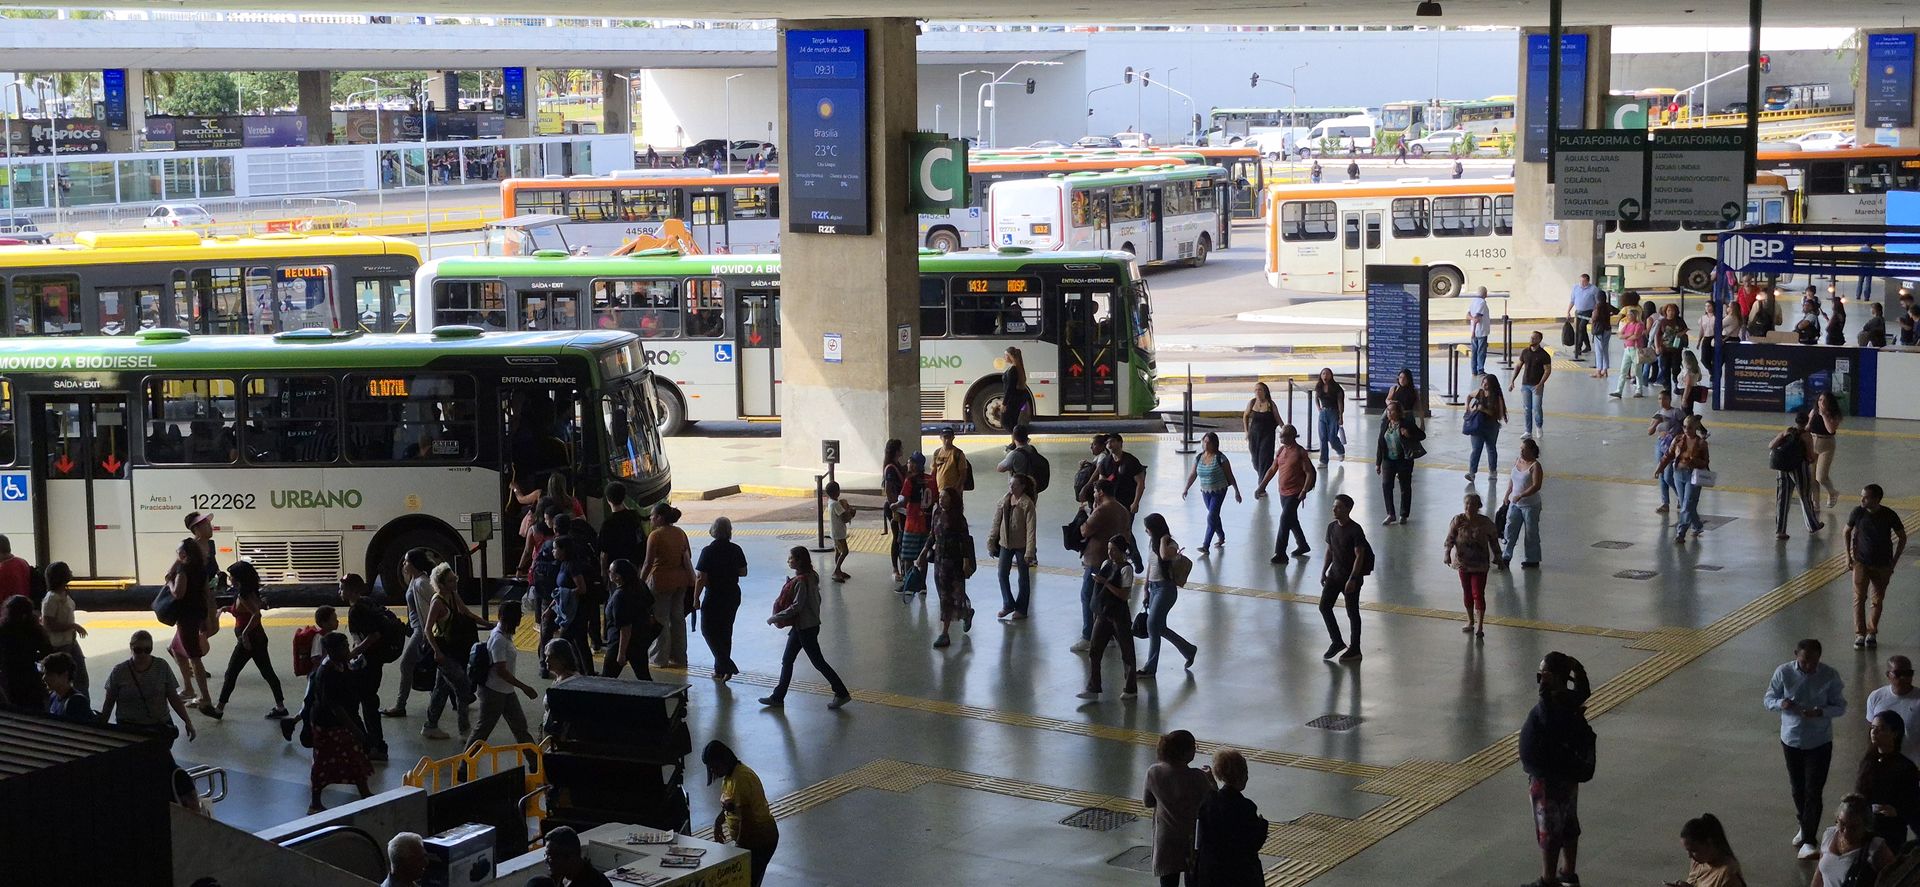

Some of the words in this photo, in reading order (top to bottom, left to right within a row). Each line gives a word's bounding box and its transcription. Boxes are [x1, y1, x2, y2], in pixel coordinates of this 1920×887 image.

[814, 65, 835, 75] 09:31
[97, 105, 105, 120] B
[1613, 104, 1639, 129] C
[813, 128, 838, 138] Brasília
[1559, 136, 1630, 146] PLATAFORMA
[1632, 136, 1641, 145] C
[1656, 135, 1730, 145] PLATAFORMA
[1733, 135, 1742, 145] D
[814, 144, 837, 157] 23°C
[920, 147, 953, 202] C
[811, 210, 829, 219] RZK
[818, 225, 836, 233] RZK
[1639, 241, 1645, 249] 4
[1750, 239, 1784, 258] BP
[1465, 247, 1507, 259] 441830
[711, 264, 753, 274] MOVIDO
[755, 264, 763, 274] A
[531, 281, 548, 289] SAÍDA
[0, 356, 56, 369] MOVIDO
[60, 357, 72, 369] A
[76, 355, 157, 369] BIODIESEL
[920, 355, 963, 369] BANO
[54, 380, 78, 389] SAÍDA
[826, 447, 835, 459] 2
[190, 493, 256, 510] 122262
[270, 489, 363, 509] URBANO
